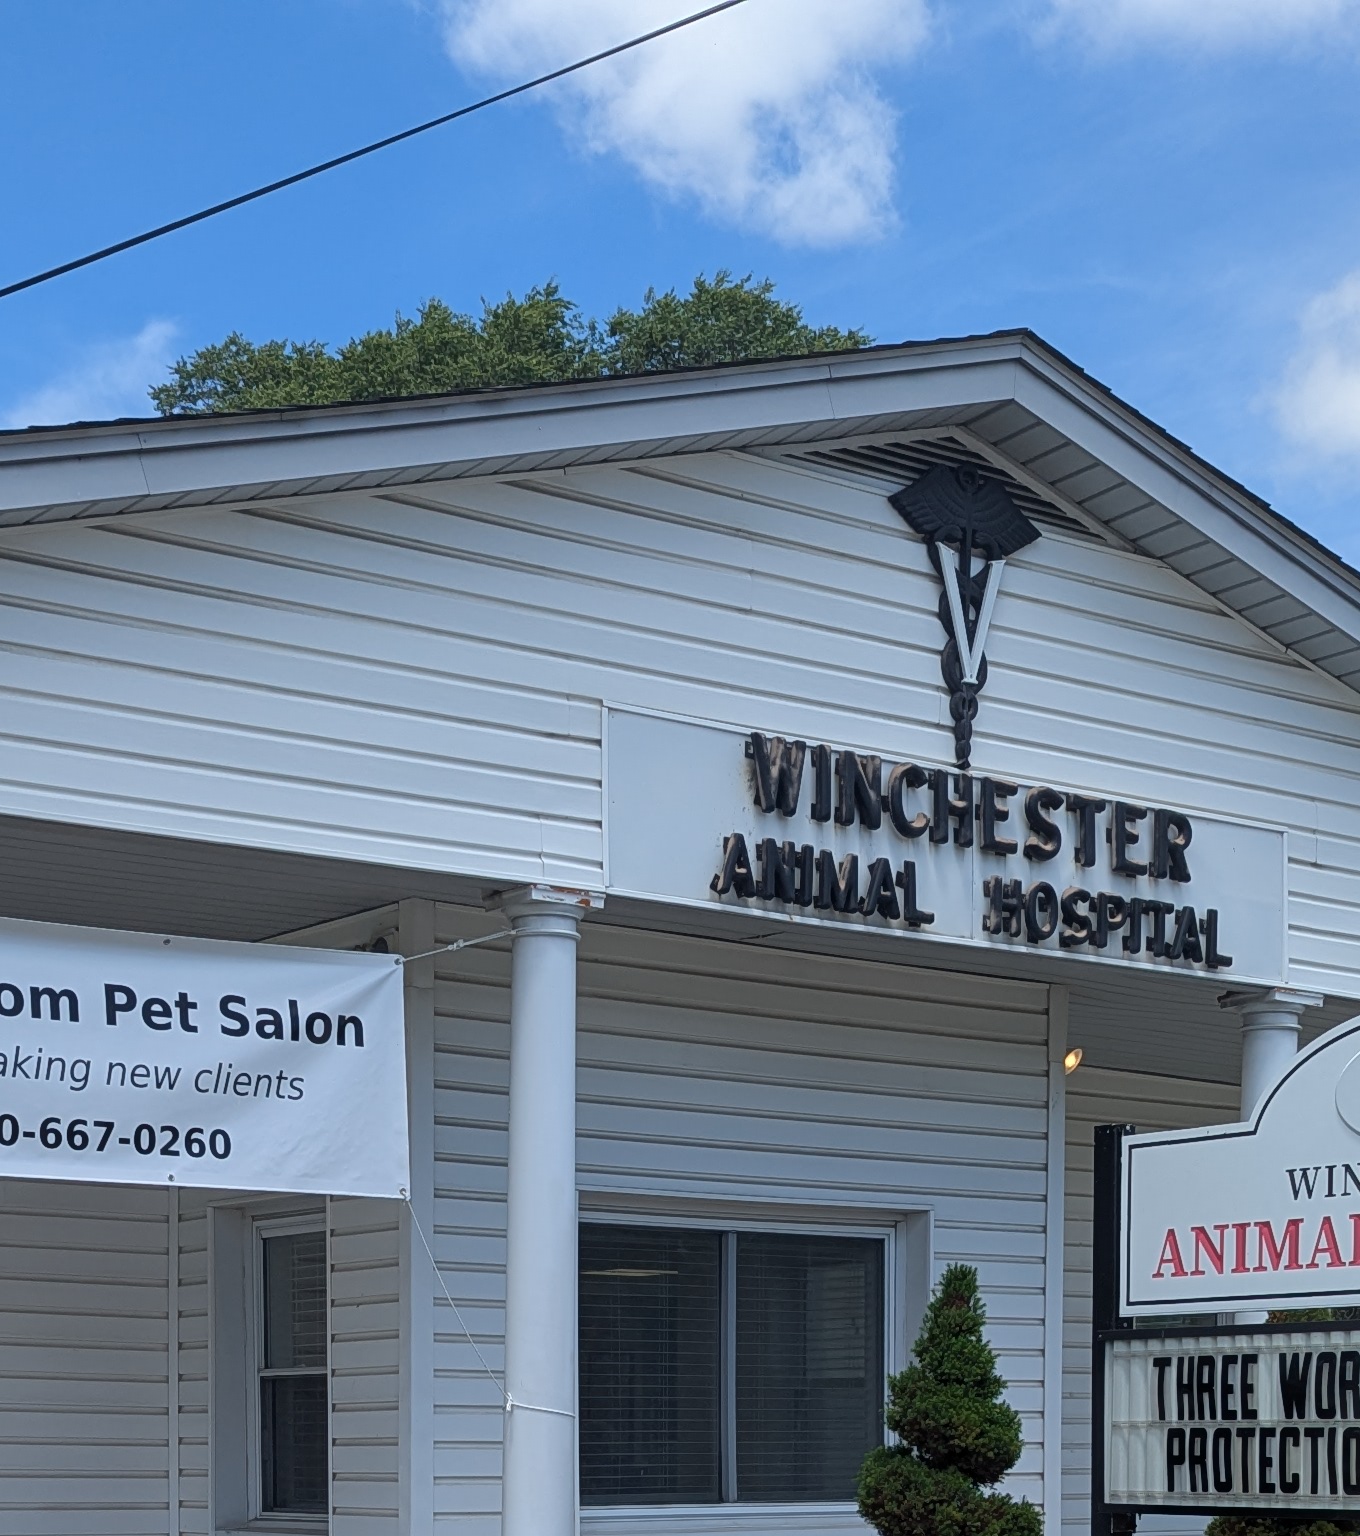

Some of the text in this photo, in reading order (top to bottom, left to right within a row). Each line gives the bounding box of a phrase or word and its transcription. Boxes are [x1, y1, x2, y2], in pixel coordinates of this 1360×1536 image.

[747, 731, 1192, 883] WINCHESTER
[710, 833, 1232, 968] ANIMAL HOSPITAL
[104, 983, 199, 1034] Pet
[220, 994, 365, 1048] Salon
[107, 1061, 182, 1091] new
[194, 1062, 305, 1101] clients
[1152, 1354, 1259, 1421] THREE
